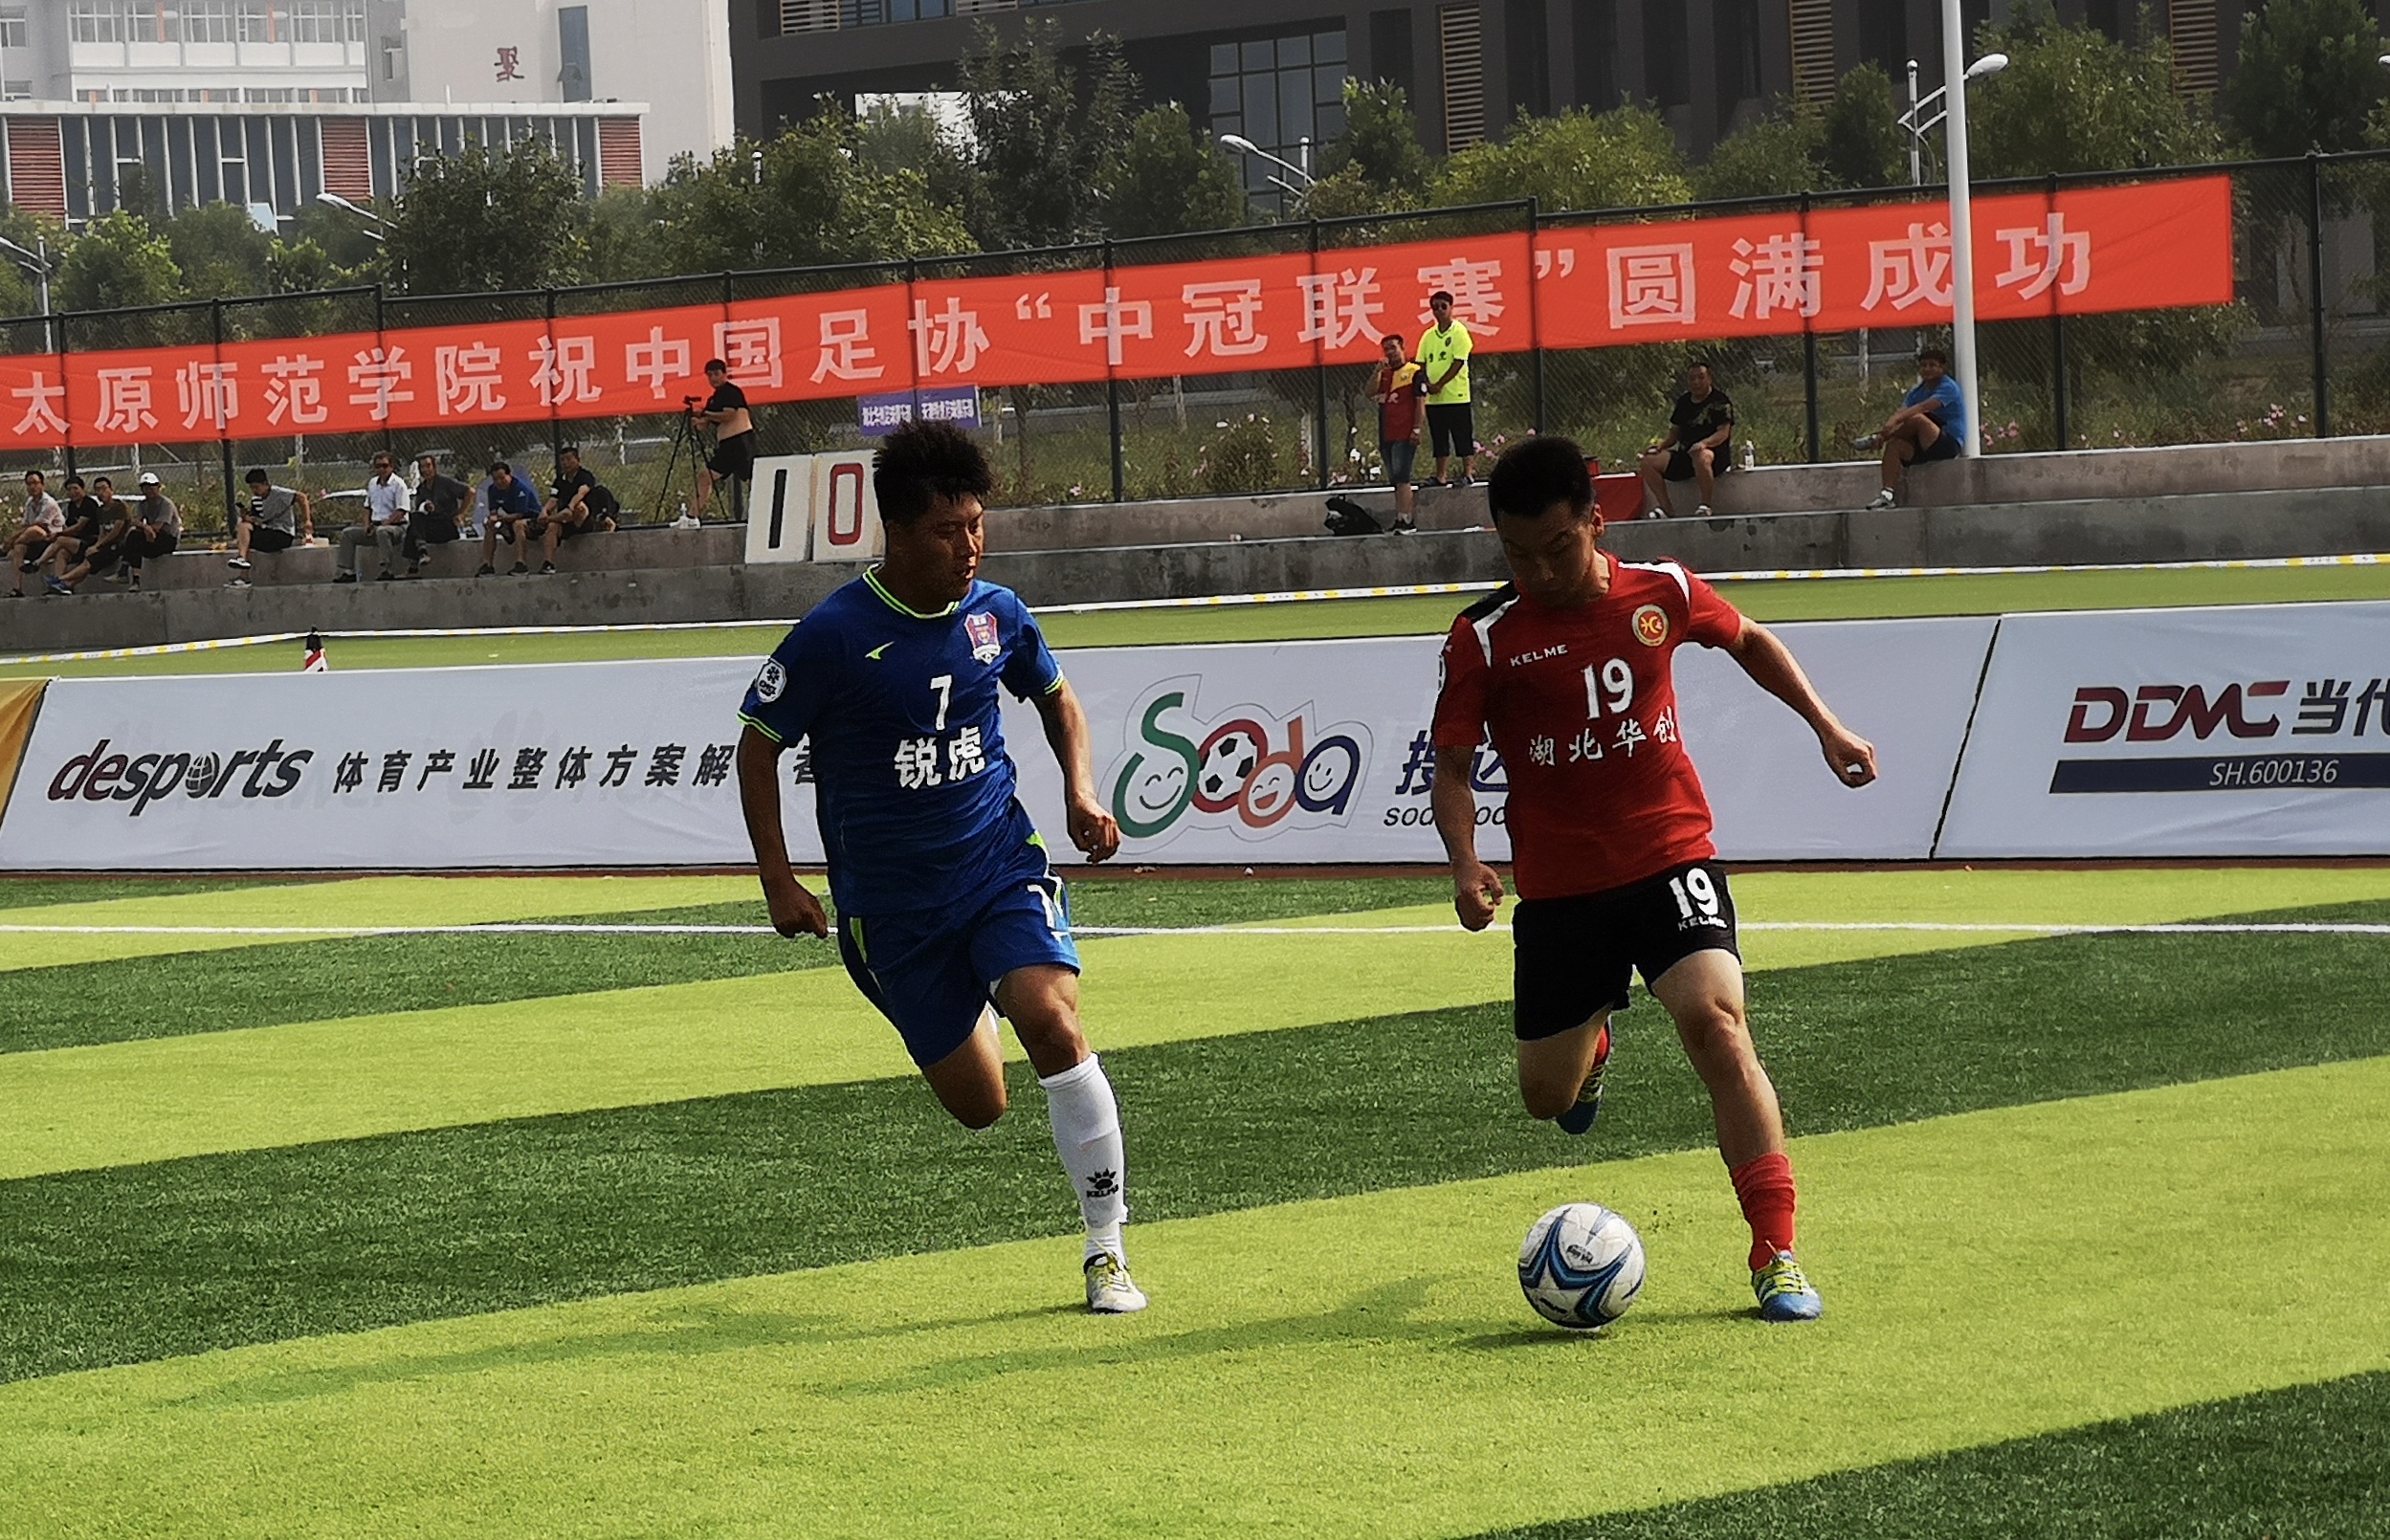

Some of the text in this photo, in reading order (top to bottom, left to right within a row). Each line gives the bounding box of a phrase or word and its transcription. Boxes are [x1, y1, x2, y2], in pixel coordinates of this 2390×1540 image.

[1510, 644, 1568, 667] KELME
[930, 674, 953, 731] 7
[1582, 657, 1634, 720] 19
[2064, 679, 2290, 743] DDMC
[894, 725, 986, 790] 锐虎
[1529, 705, 1677, 765] 湖北华创
[47, 738, 315, 817] desports
[2209, 759, 2340, 787] SH.600136
[1669, 867, 1718, 919] 19
